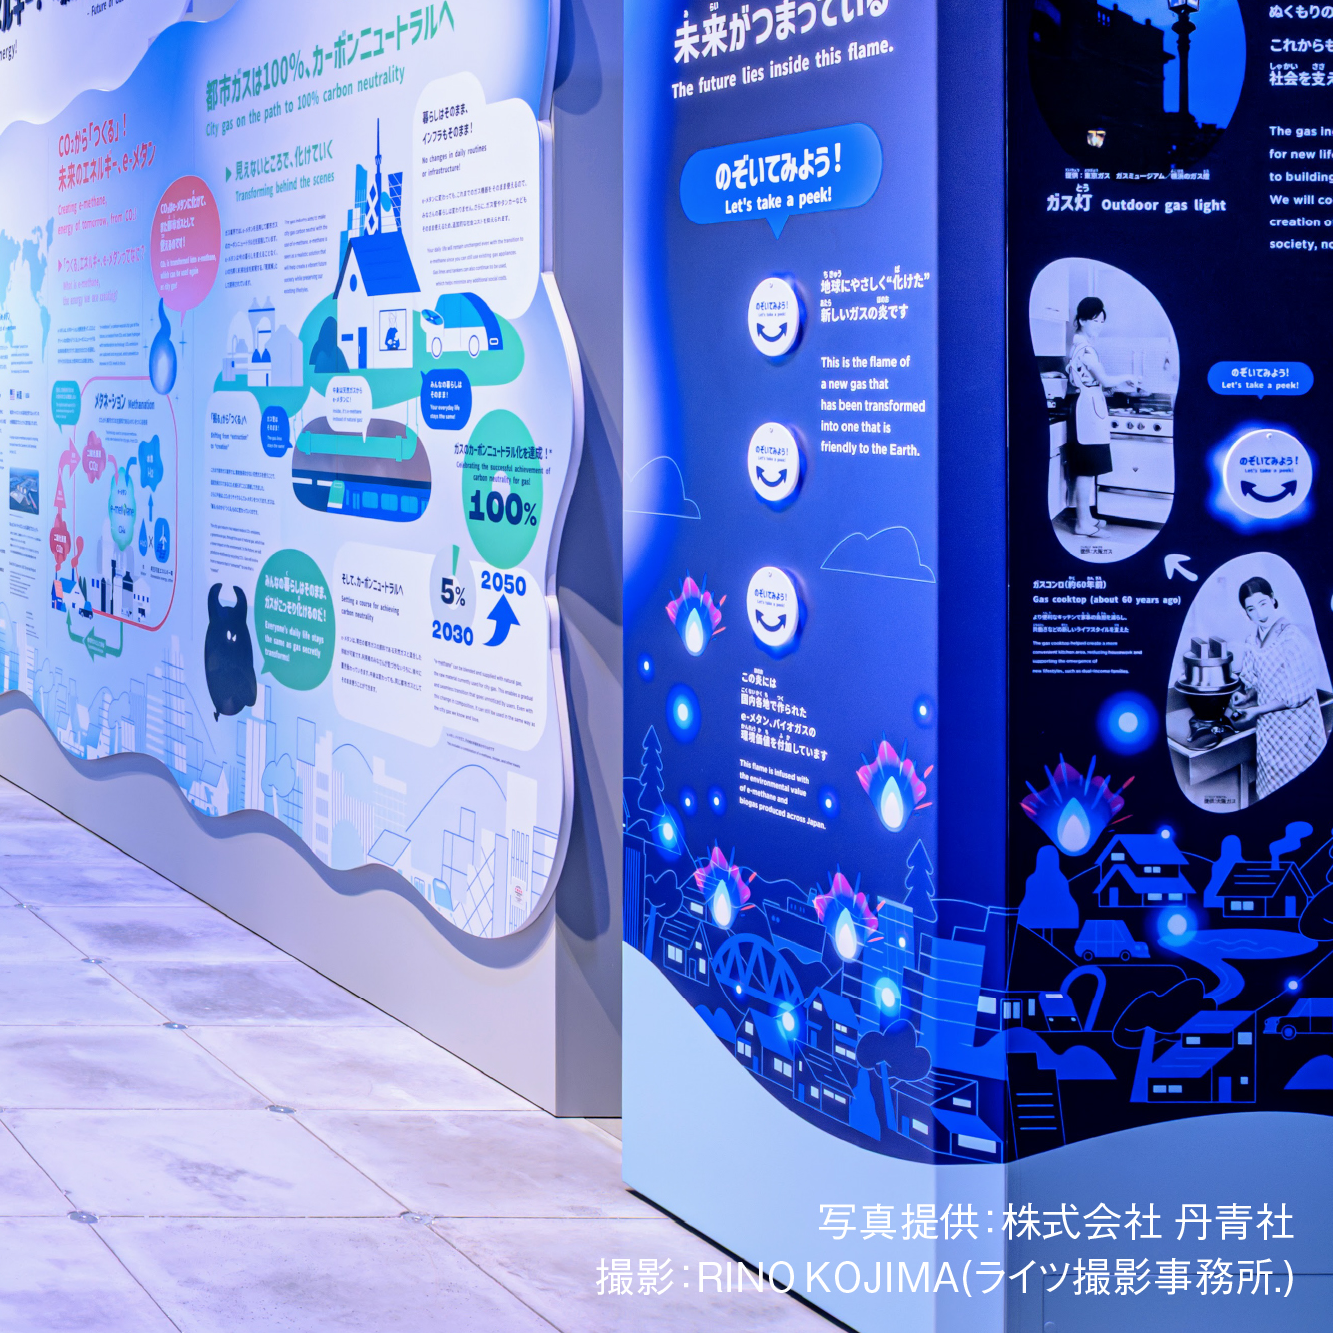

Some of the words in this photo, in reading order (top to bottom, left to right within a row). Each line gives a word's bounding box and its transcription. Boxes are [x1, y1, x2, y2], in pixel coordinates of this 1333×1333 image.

[672, 81, 694, 99] The
[698, 73, 736, 94] future
[742, 65, 765, 84] lies
[769, 55, 810, 78] inside
[815, 46, 842, 68] this
[848, 39, 894, 61] flame.
[206, 124, 219, 138] City
[222, 120, 233, 135] gas
[249, 109, 261, 123] the
[264, 102, 281, 123] path
[298, 90, 319, 110] 100%
[323, 82, 353, 103] carbon
[358, 65, 405, 93] neutrality
[715, 142, 841, 191] のぞいてみよう！
[235, 182, 273, 202] Transforming
[275, 178, 297, 193] behind
[313, 171, 334, 185] scenes
[725, 197, 752, 214] Let's
[757, 194, 782, 210] take
[799, 186, 832, 208] peek!
[1047, 193, 1093, 211] ガス灯
[1101, 199, 1159, 211] Outdoor
[1165, 202, 1188, 214] gas
[1194, 199, 1227, 214] light
[1269, 217, 1321, 226] creation
[1269, 239, 1318, 251] society,
[820, 304, 909, 323] 新しいガスの炎です
[821, 357, 840, 368] This
[852, 357, 868, 368] the
[870, 356, 897, 368] flame
[1231, 367, 1290, 378] のぞいてみよう！
[829, 381, 848, 389] new
[850, 381, 866, 391] gas
[869, 378, 889, 389] that
[821, 399, 836, 411] has
[839, 399, 862, 411] been
[865, 400, 925, 412] transformed
[821, 420, 838, 431] into
[841, 423, 859, 432] one
[862, 421, 881, 433] that
[821, 441, 857, 455] friendly
[872, 443, 887, 454] the
[890, 444, 920, 456] Earth.
[1239, 455, 1299, 466] のぞいてみよう！
[469, 490, 537, 526] 100%
[441, 577, 466, 606] 5%
[481, 570, 527, 596] 2050
[1052, 596, 1087, 605] cooktop
[1090, 595, 1119, 605] (about
[1136, 597, 1159, 605] years
[1163, 596, 1181, 605] ago)
[432, 620, 474, 646] 2030
[742, 671, 777, 688] この炎には
[741, 693, 807, 719] 国内各地で作られた
[741, 729, 828, 762] 環境価値を付加しています
